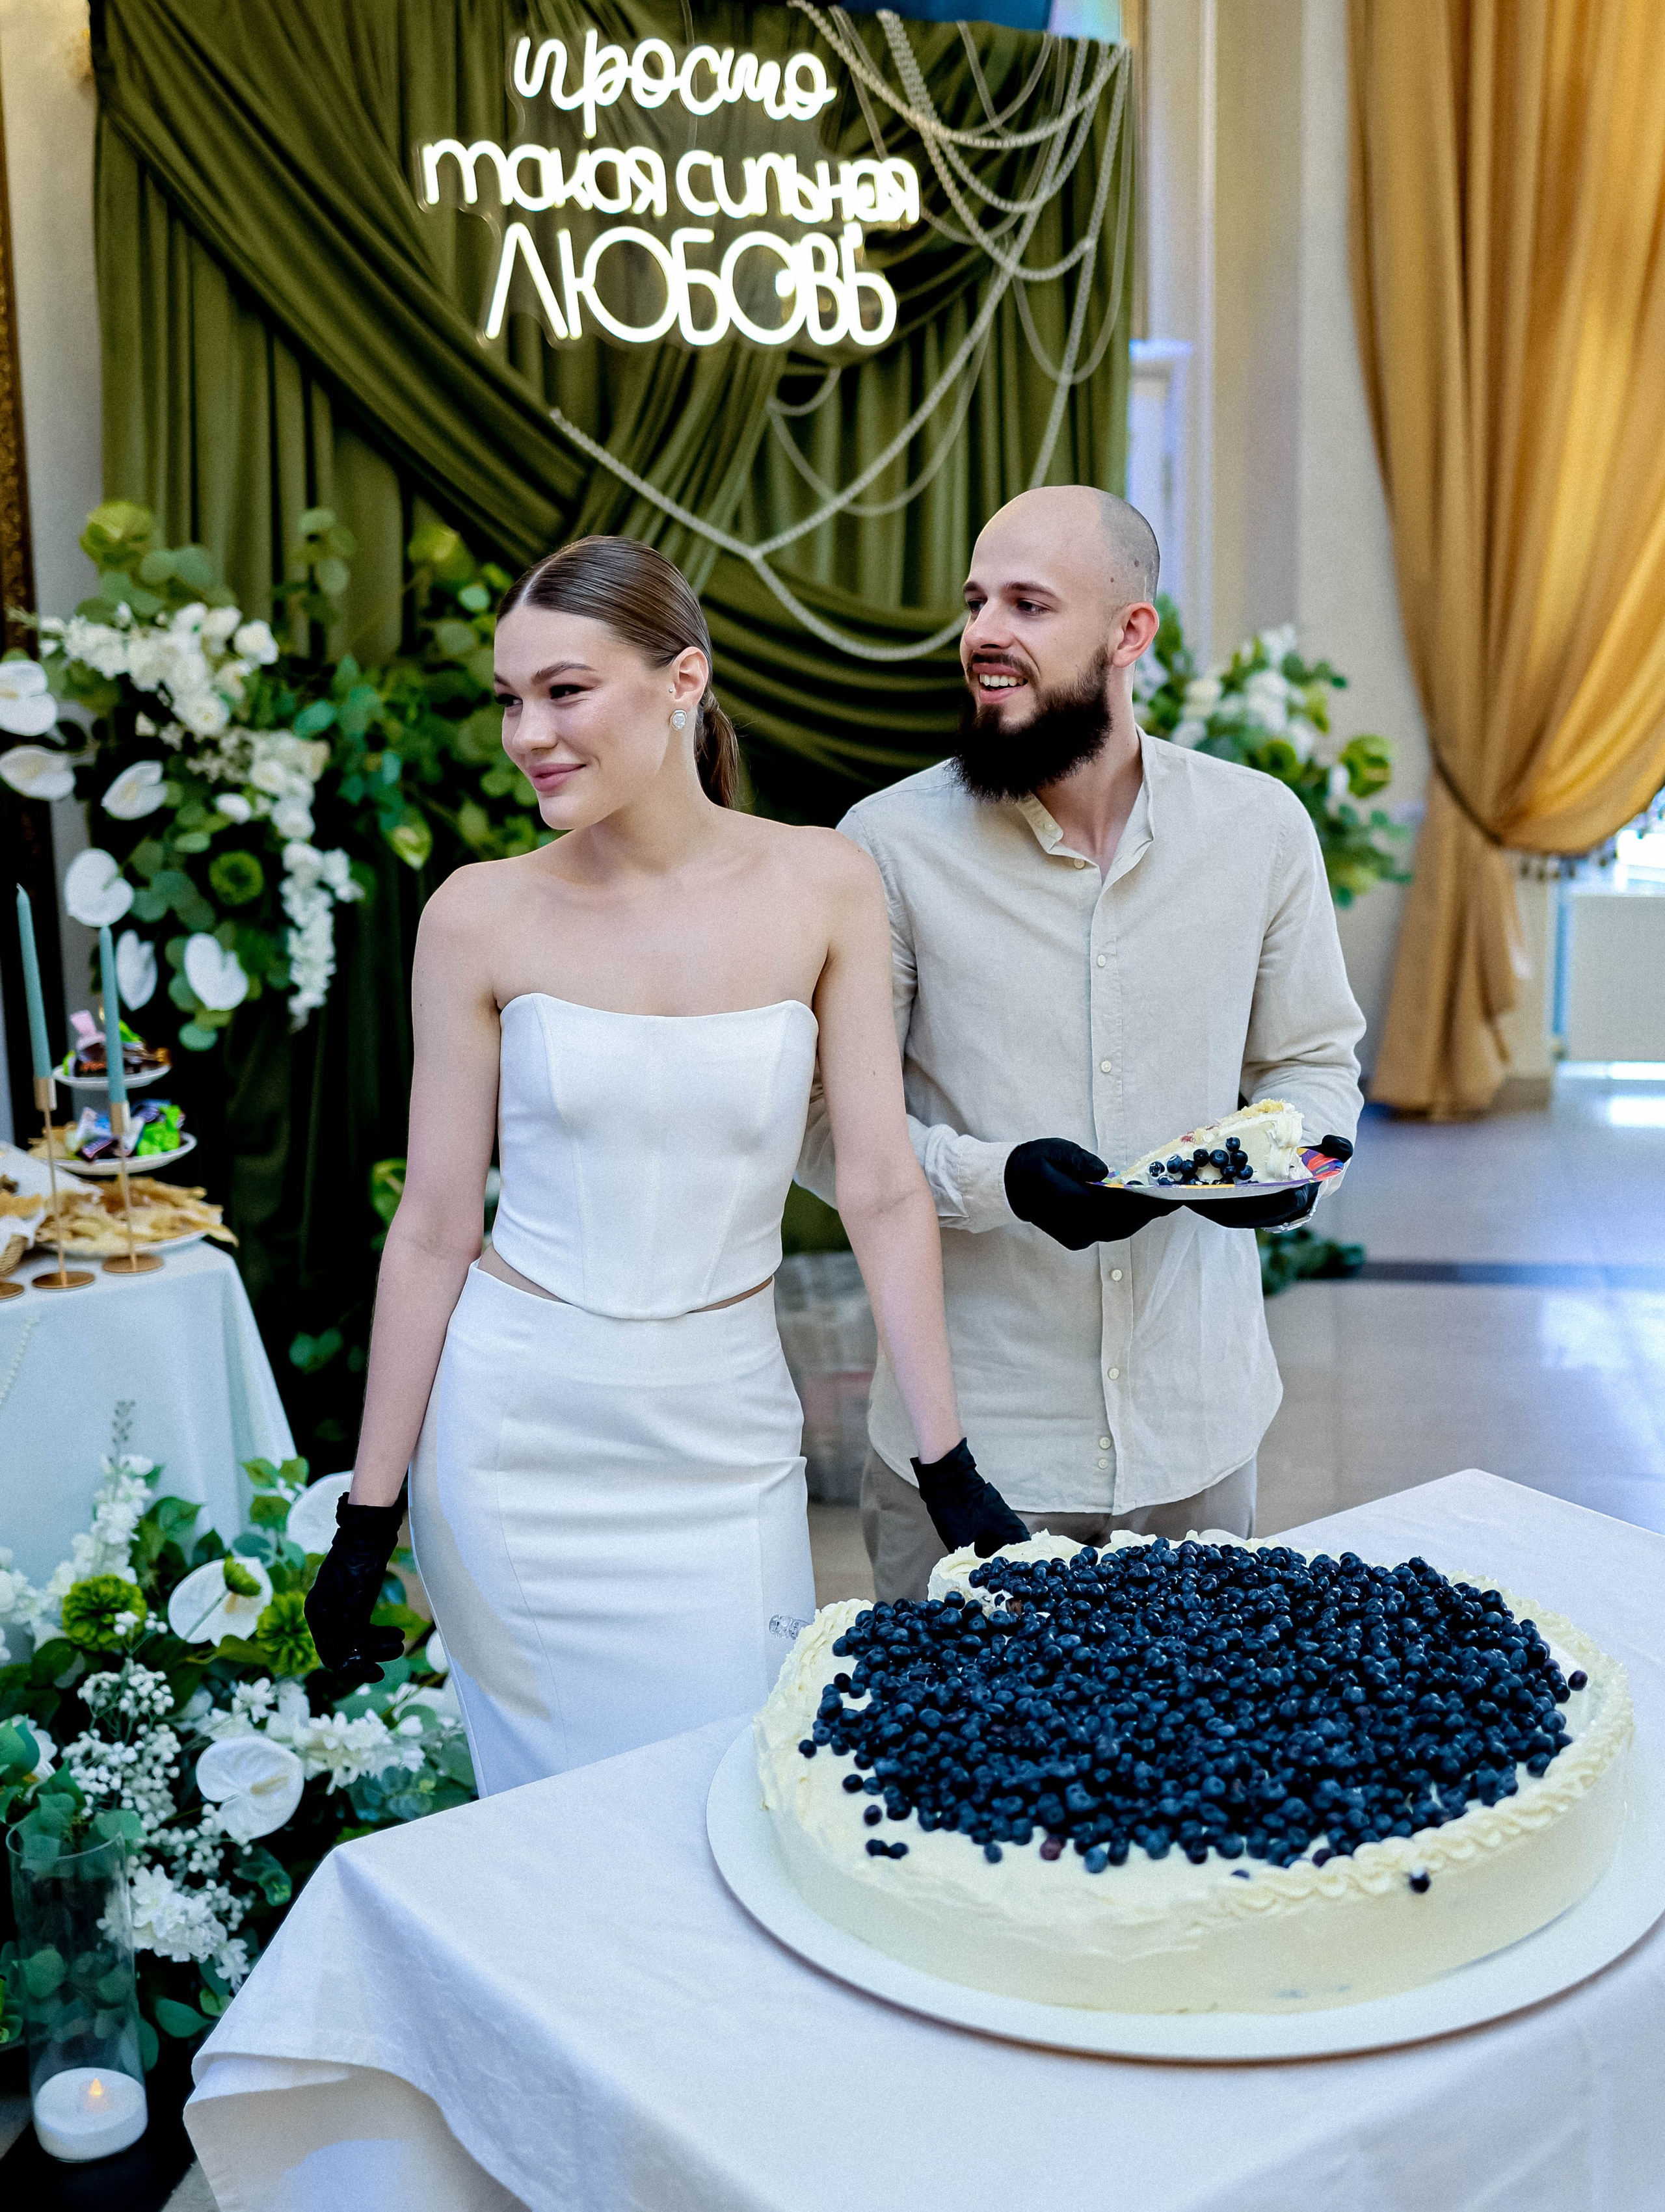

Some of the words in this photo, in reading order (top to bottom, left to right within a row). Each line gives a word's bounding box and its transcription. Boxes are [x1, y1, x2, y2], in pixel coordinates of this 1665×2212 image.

[513, 29, 836, 138] просто
[423, 139, 667, 217] такая
[675, 150, 920, 224] сильная
[486, 222, 898, 346] ЛЮБОВЬ
